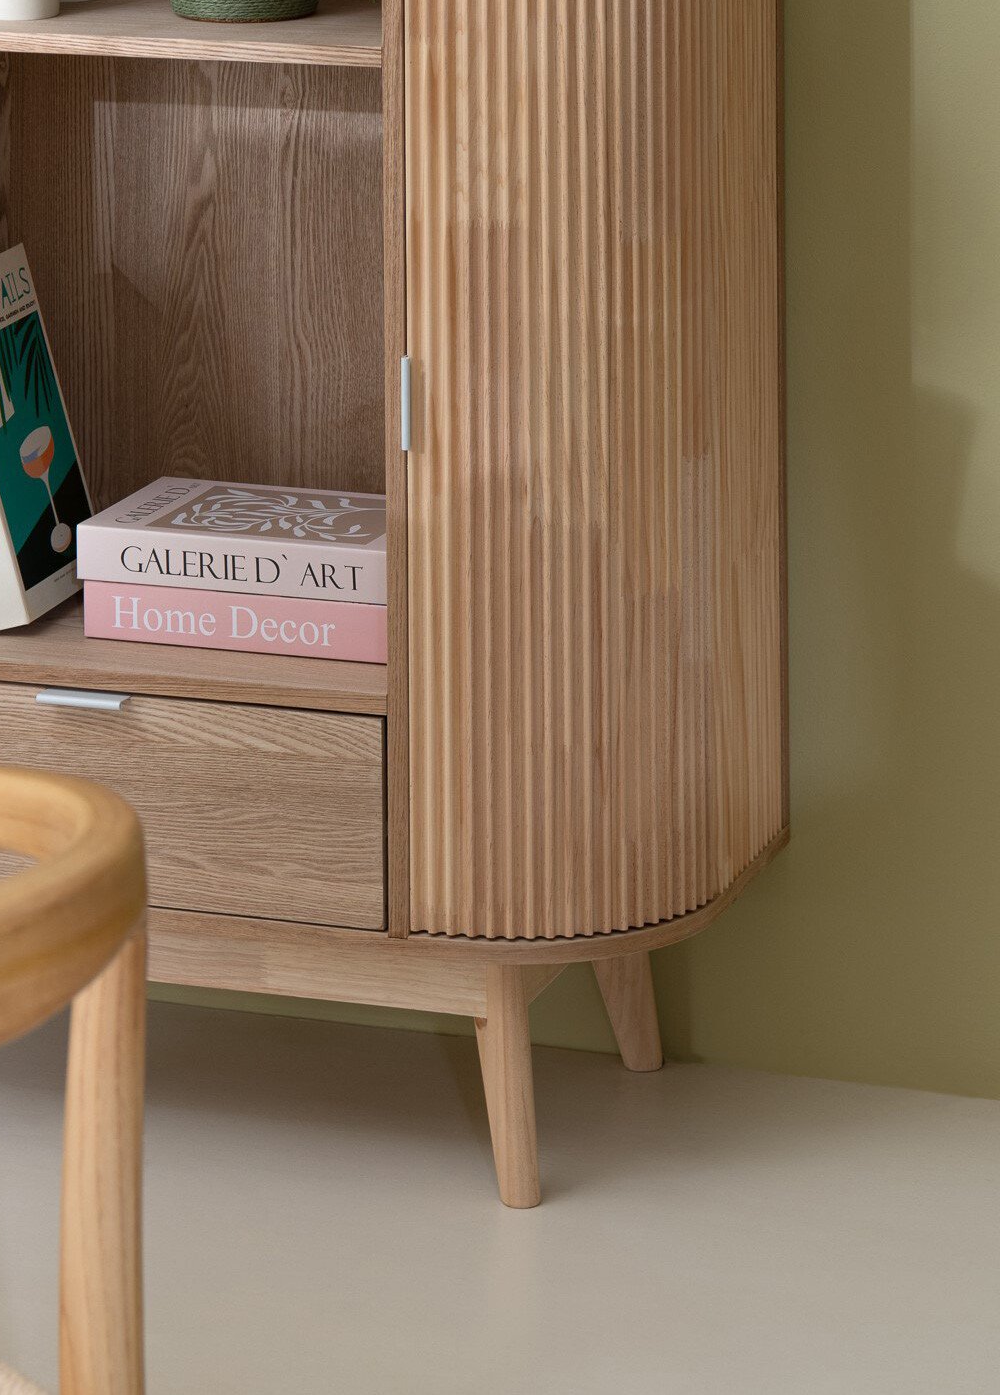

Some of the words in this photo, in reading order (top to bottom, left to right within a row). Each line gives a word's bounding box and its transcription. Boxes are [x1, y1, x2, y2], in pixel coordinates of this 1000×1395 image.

[120, 545, 248, 582] GALERIE
[300, 562, 364, 591] ART
[111, 595, 217, 636] Home
[228, 605, 336, 647] Decor
